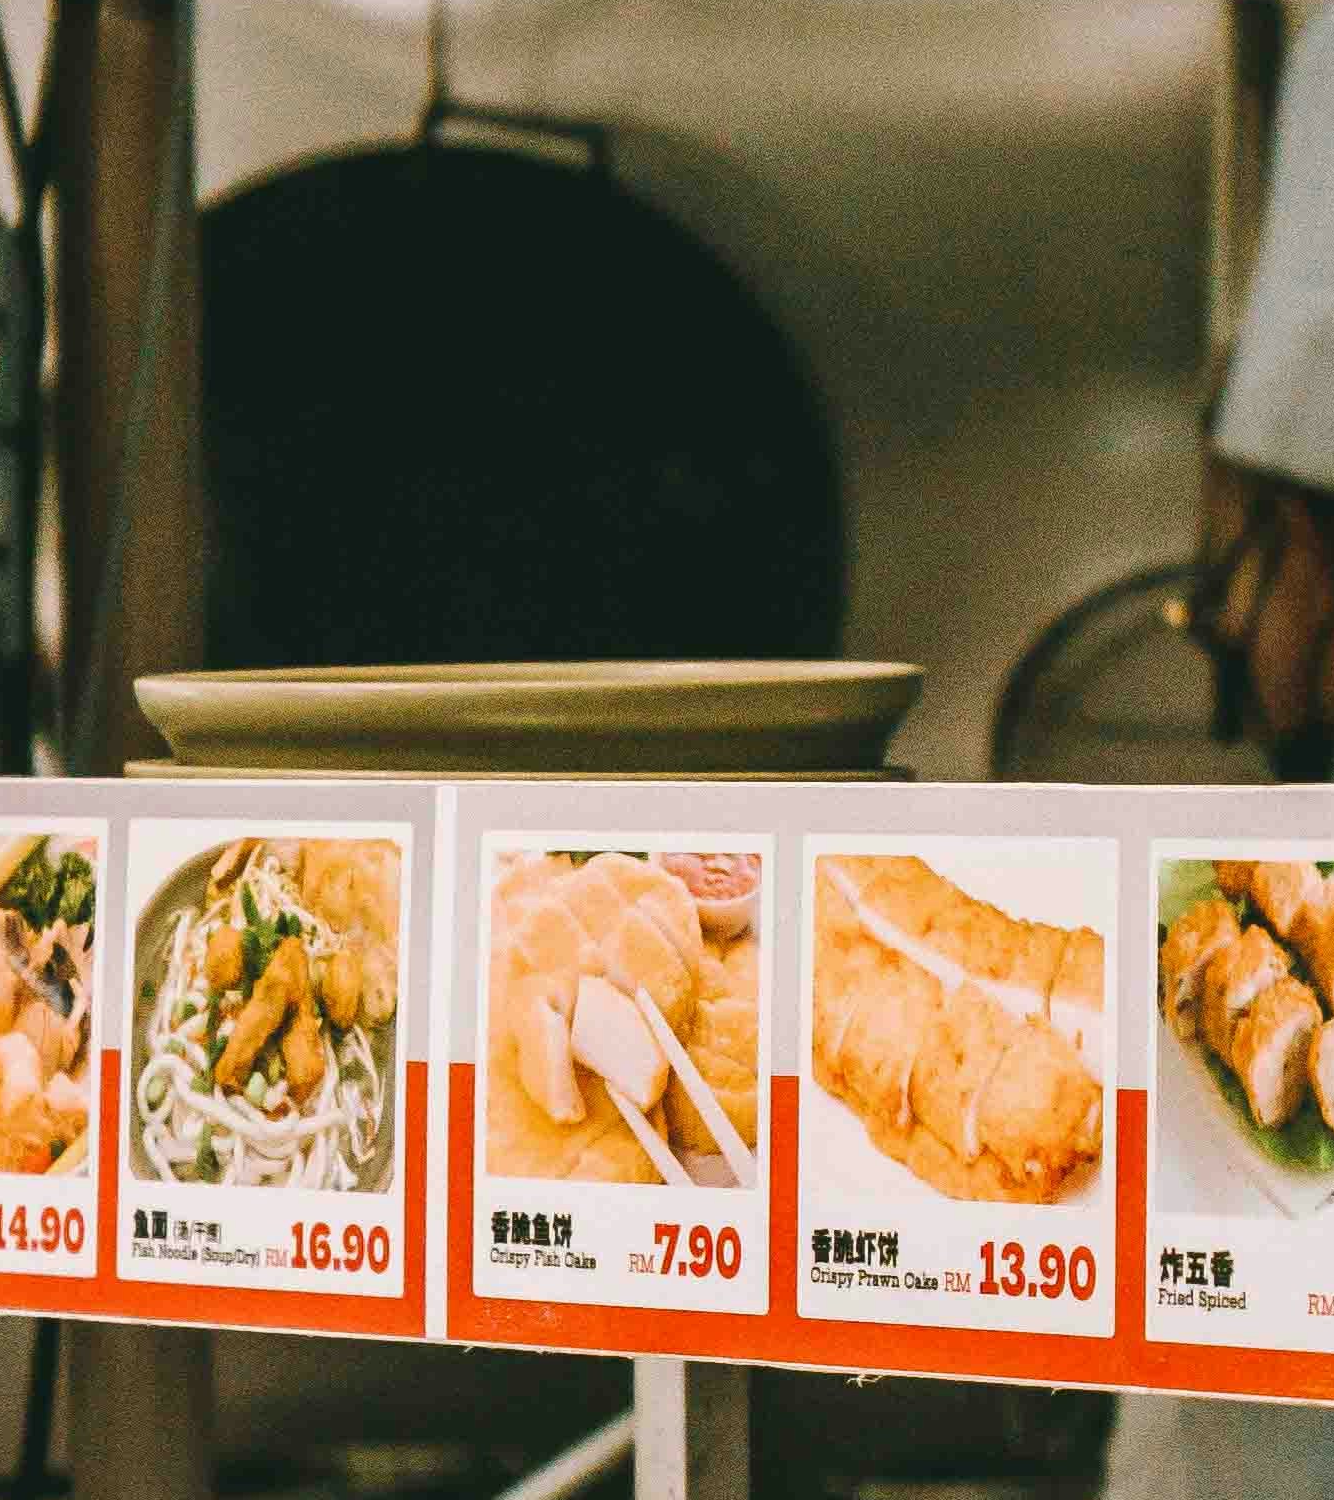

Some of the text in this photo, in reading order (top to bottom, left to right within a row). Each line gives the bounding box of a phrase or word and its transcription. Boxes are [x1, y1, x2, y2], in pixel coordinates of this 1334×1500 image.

[291, 1221, 391, 1275] 16.90
[490, 1247, 597, 1270] Crispy Fish Cake
[628, 1222, 742, 1280] RM 7.90
[1159, 1246, 1234, 1288] 炸五香
[809, 1266, 939, 1291] Crispy Prawn Cake
[943, 1240, 1097, 1302] RM 13.90
[1157, 1287, 1247, 1312] Fried Spiced
